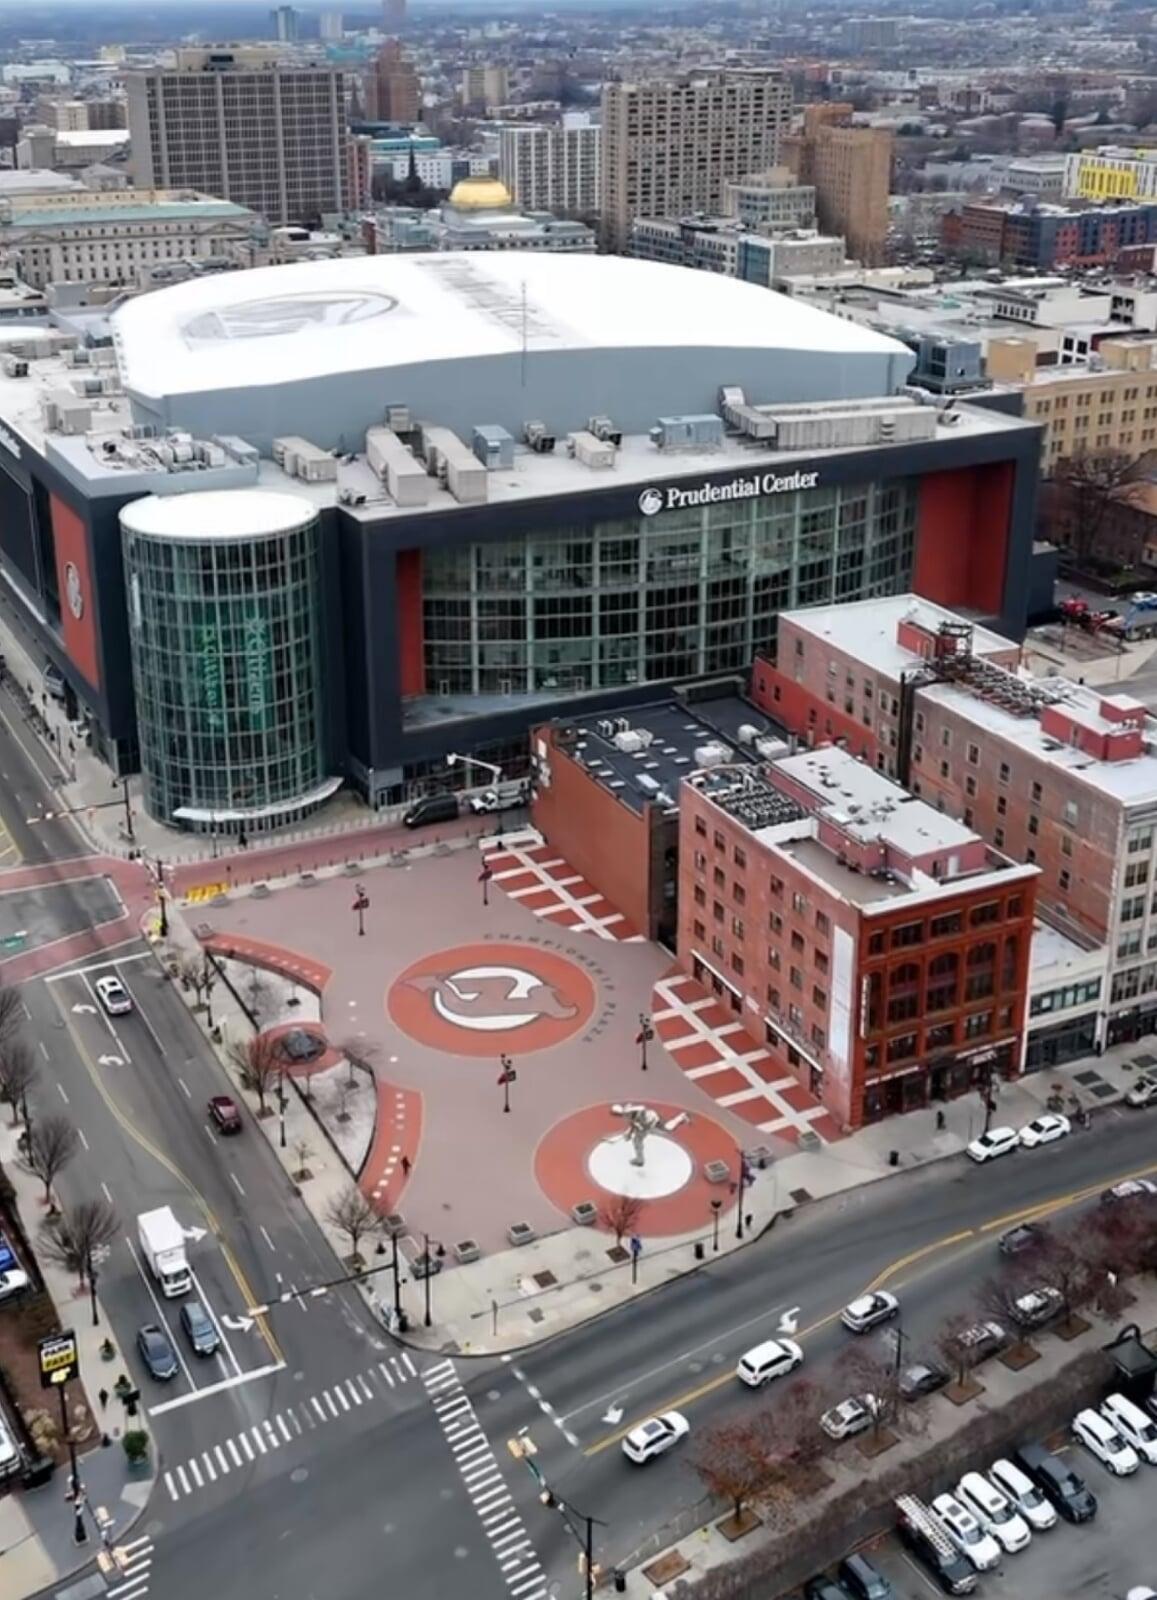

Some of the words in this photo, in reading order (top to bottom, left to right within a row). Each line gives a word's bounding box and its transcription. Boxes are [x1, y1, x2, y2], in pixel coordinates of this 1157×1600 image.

[666, 475, 760, 508] Prudential
[762, 470, 819, 493] Center
[484, 933, 615, 991] CHAMPIONSHIP
